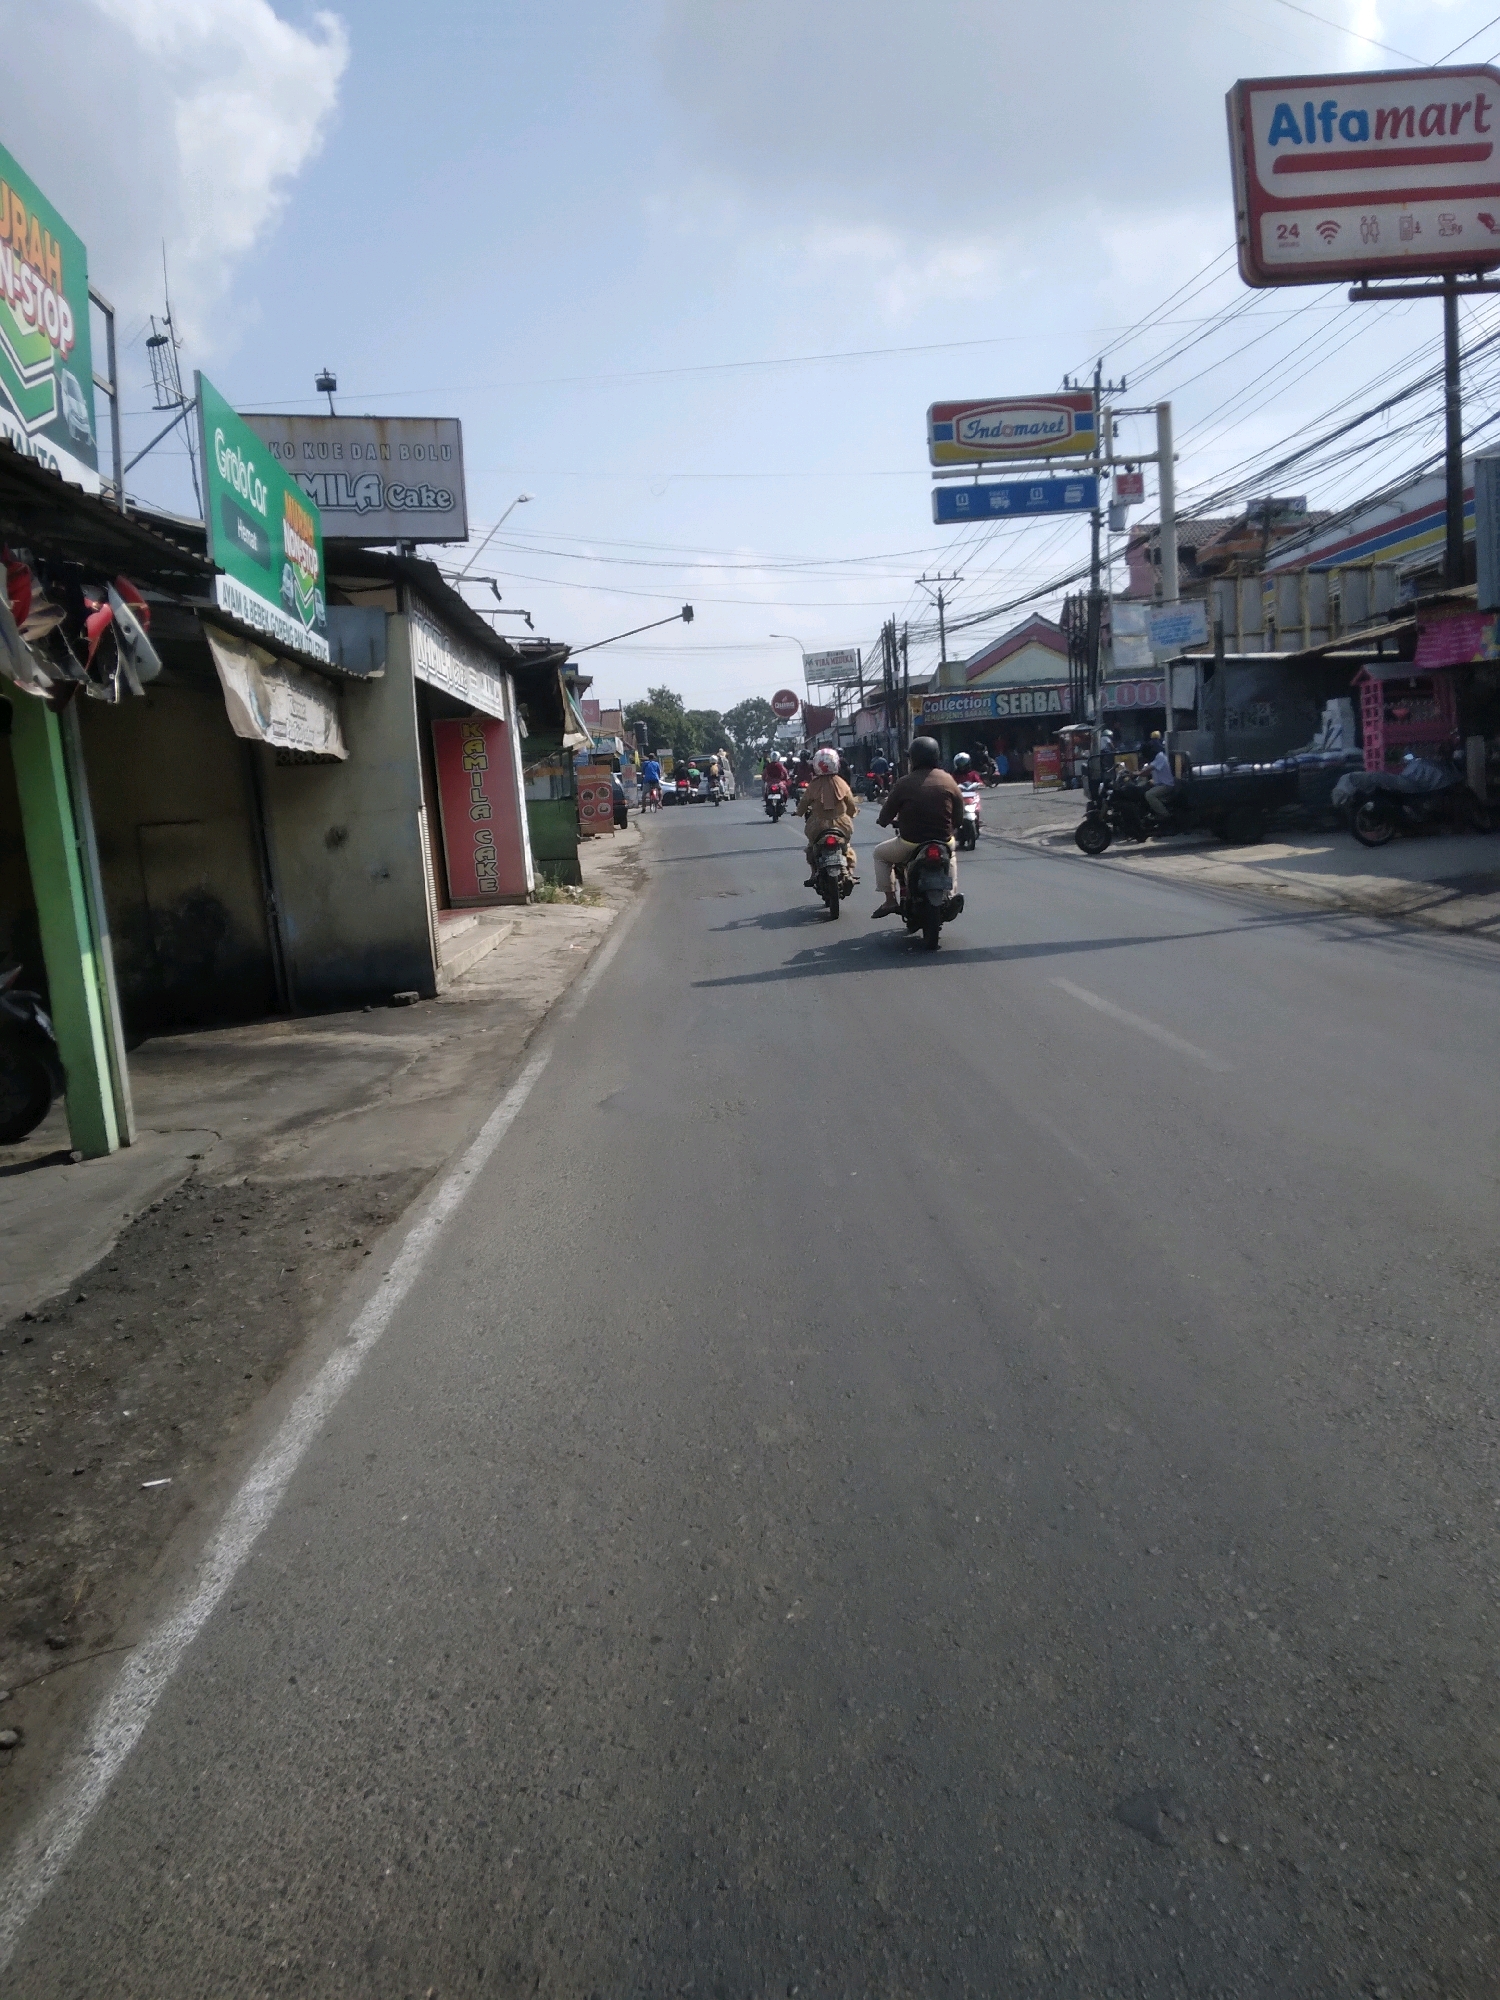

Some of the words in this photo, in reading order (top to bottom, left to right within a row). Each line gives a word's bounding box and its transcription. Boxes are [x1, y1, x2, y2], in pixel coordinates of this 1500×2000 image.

[1268, 93, 1493, 146] Alfamart
[1276, 222, 1300, 240] 24
[963, 415, 1065, 440] Indomaret
[303, 442, 344, 460] KUE
[351, 443, 392, 461] DAN
[399, 443, 453, 462] BOLU
[215, 427, 268, 518] GrabCar
[291, 472, 384, 516] MILA
[385, 483, 454, 511] Cake
[237, 516, 258, 551] Hemat
[923, 696, 991, 713] Collection
[996, 690, 1062, 715] SERBA
[461, 722, 494, 822] KAMILA
[474, 829, 499, 894] CAKE
